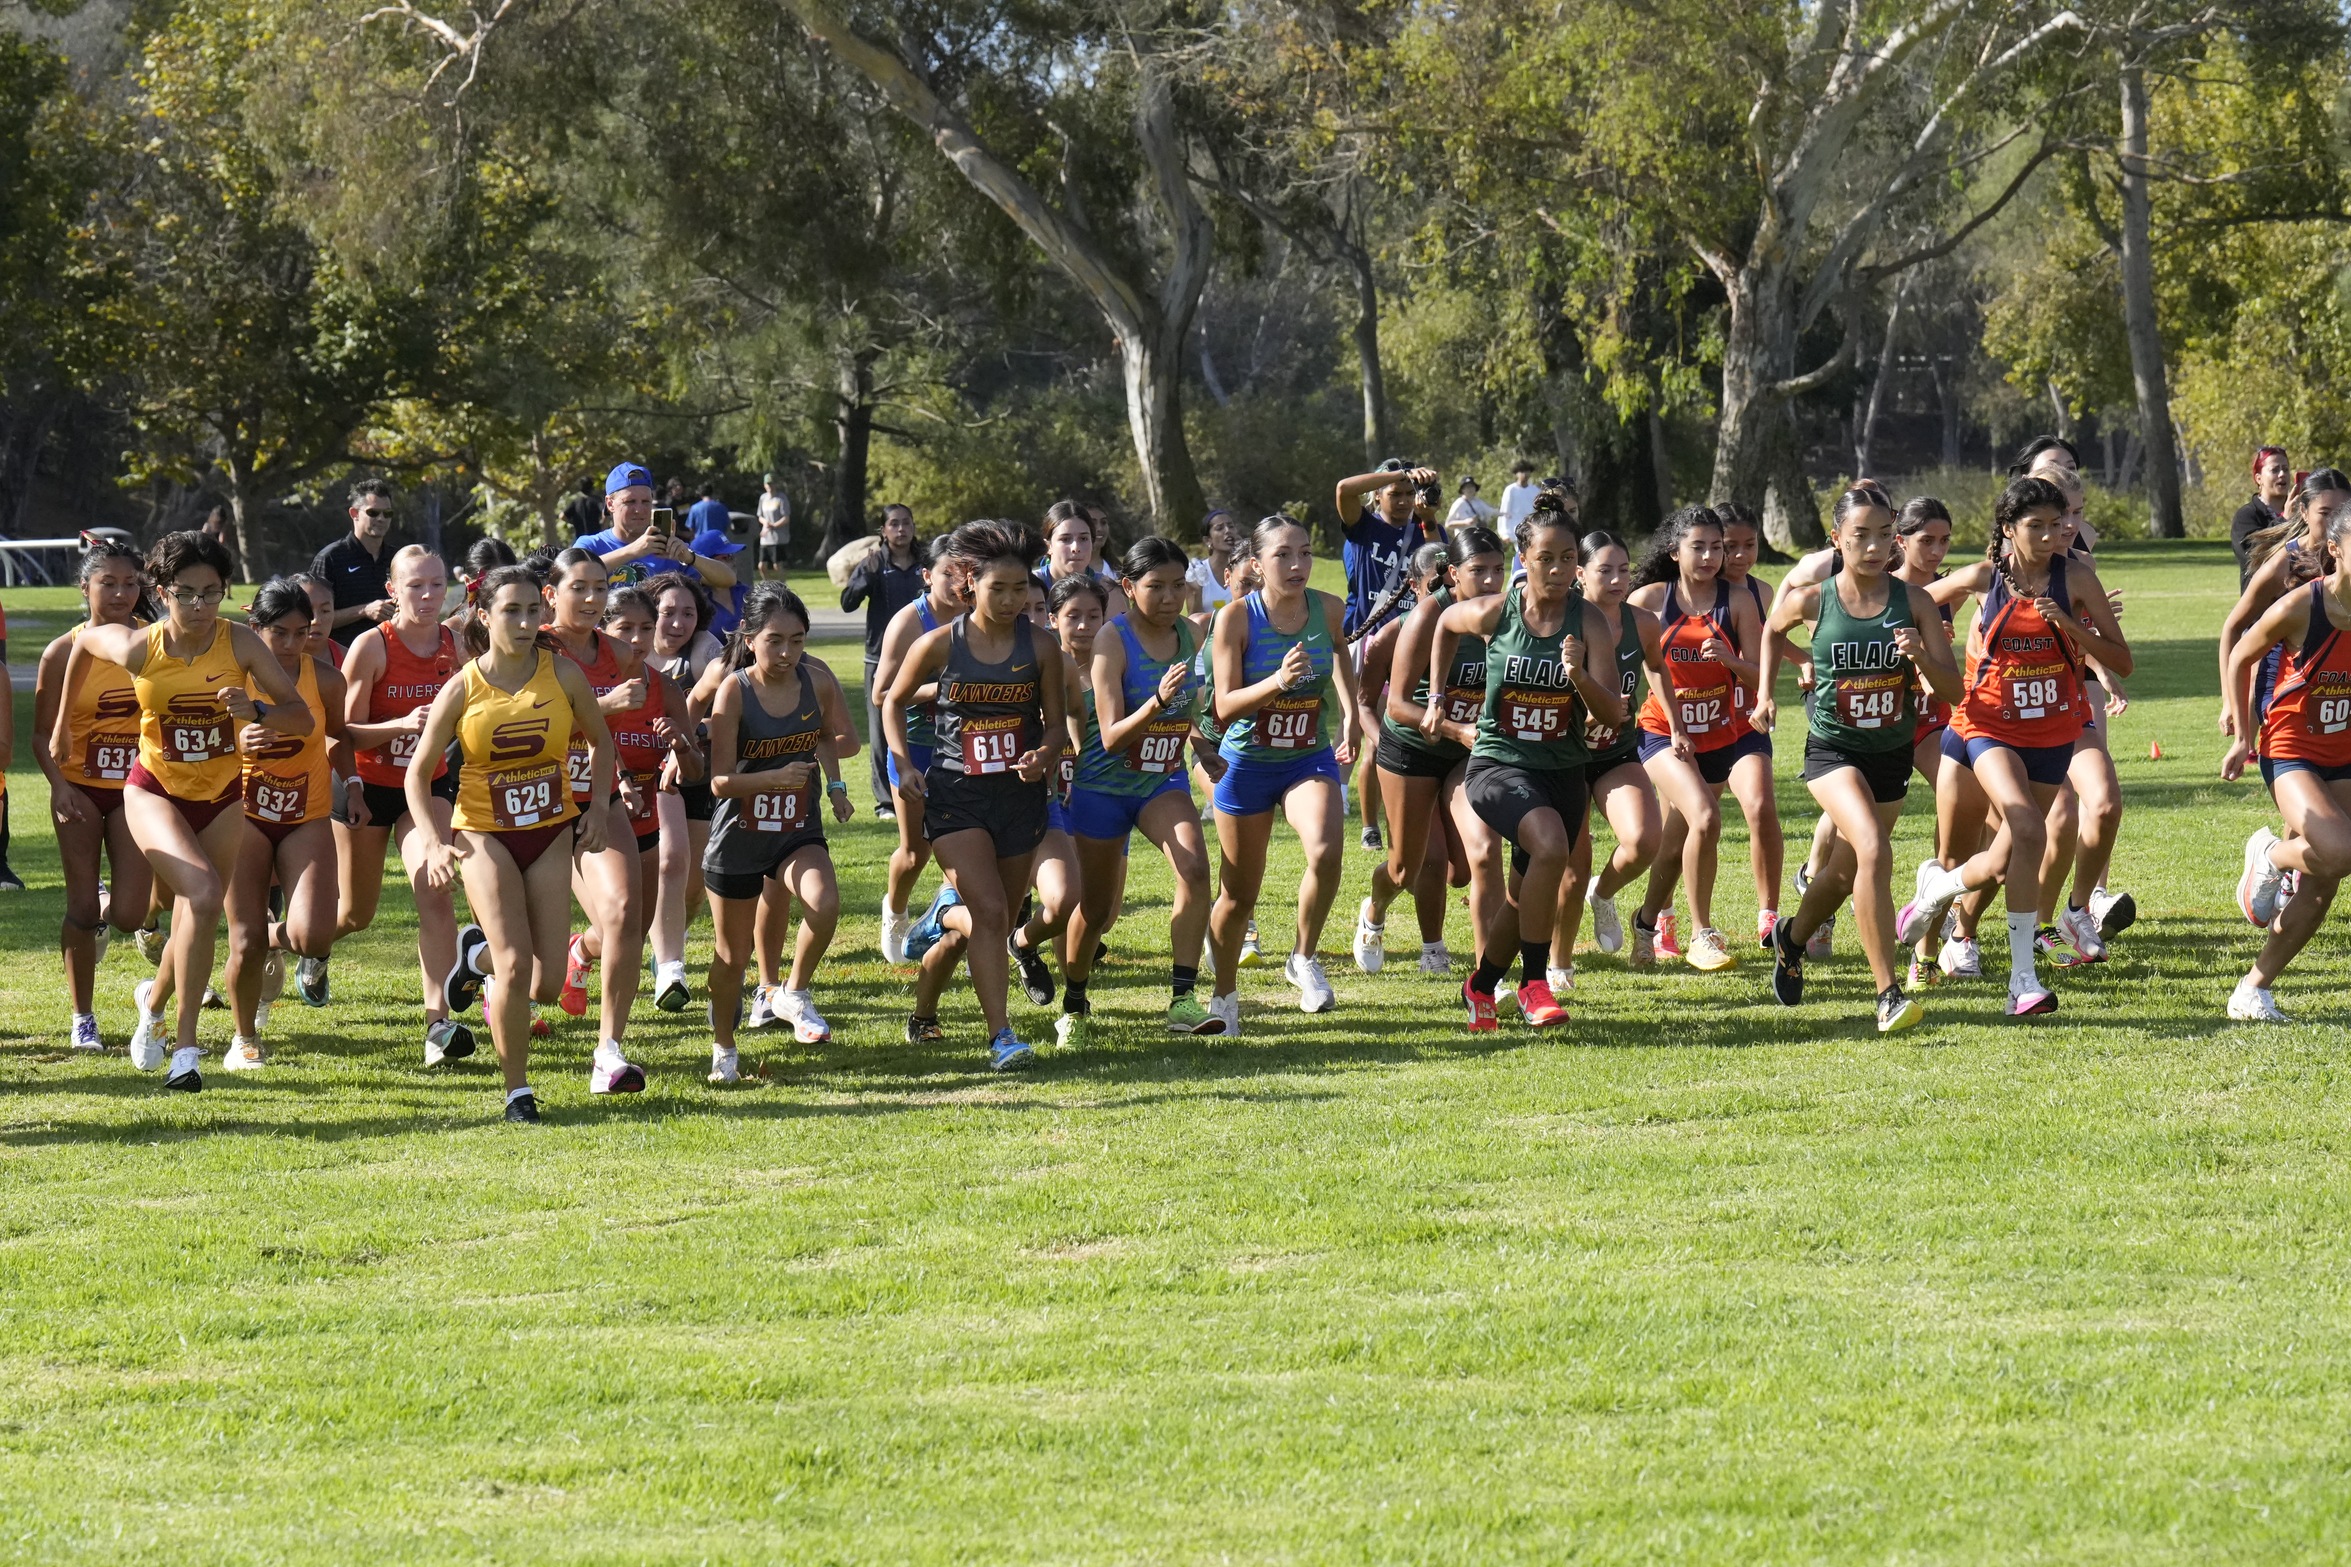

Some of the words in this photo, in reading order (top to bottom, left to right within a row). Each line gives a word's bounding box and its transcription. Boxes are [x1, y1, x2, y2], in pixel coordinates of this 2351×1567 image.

[1670, 648, 1718, 662] COA
[1831, 641, 1901, 670] ELAC
[2001, 637, 2055, 652] COAST
[1457, 661, 1486, 686] EL
[1504, 654, 1570, 689] ELAC
[2002, 665, 2049, 678] Athletic
[387, 684, 442, 699] RIVERS
[949, 681, 1035, 703] LANCERS
[1839, 678, 1888, 690] Athletic
[2012, 678, 2058, 708] 598
[1504, 690, 1552, 704] Athletic
[1849, 691, 1894, 718] 548
[162, 715, 211, 726] Athletic
[1512, 706, 1559, 731] 545
[1681, 699, 1721, 723] 602
[2320, 699, 2351, 723] 60
[962, 719, 1007, 732] Athletic
[1148, 721, 1175, 733] thletic
[1267, 713, 1309, 737] 610
[90, 733, 134, 744] Athletic
[174, 727, 222, 751] 634
[390, 733, 420, 757] 62
[743, 728, 821, 759] LANCERS
[973, 732, 1016, 762] 619
[1140, 737, 1181, 762] 608
[97, 747, 137, 769] 631
[567, 755, 592, 781] 62
[251, 770, 295, 788] Athletic
[491, 768, 540, 786] Athletic
[540, 764, 557, 777] NET
[256, 785, 299, 812] 632
[505, 781, 550, 815] 629
[753, 794, 797, 820] 618
